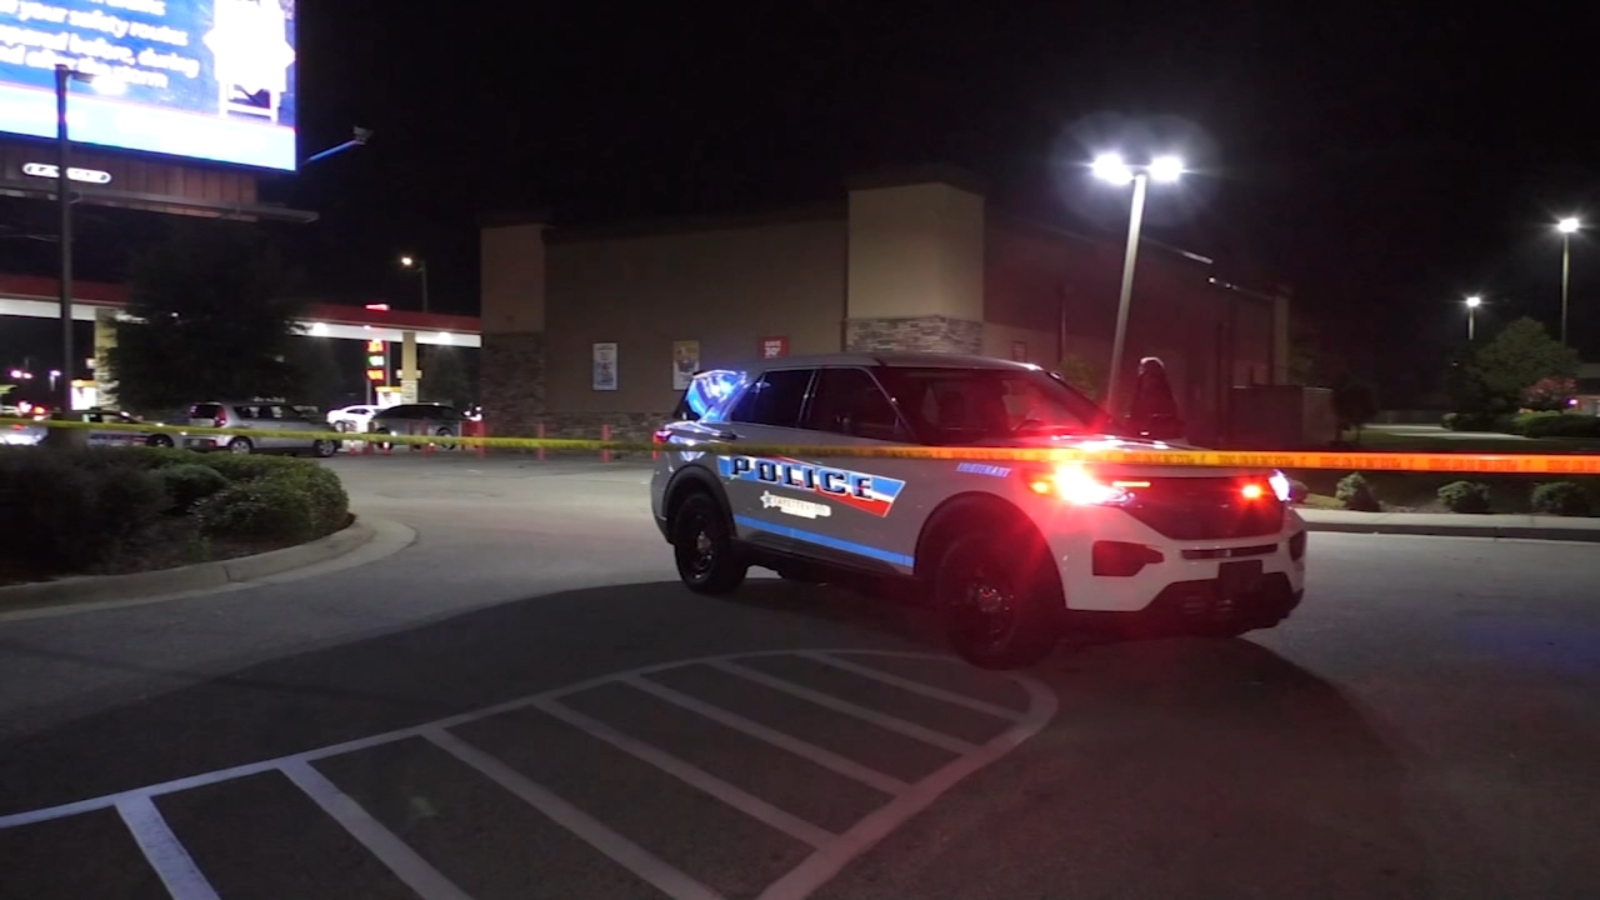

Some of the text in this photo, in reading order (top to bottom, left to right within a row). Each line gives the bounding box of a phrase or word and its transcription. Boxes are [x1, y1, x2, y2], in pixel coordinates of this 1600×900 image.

[69, 10, 129, 38] safety
[129, 22, 188, 46] routes
[138, 47, 200, 79] during
[729, 455, 876, 500] POLICE
